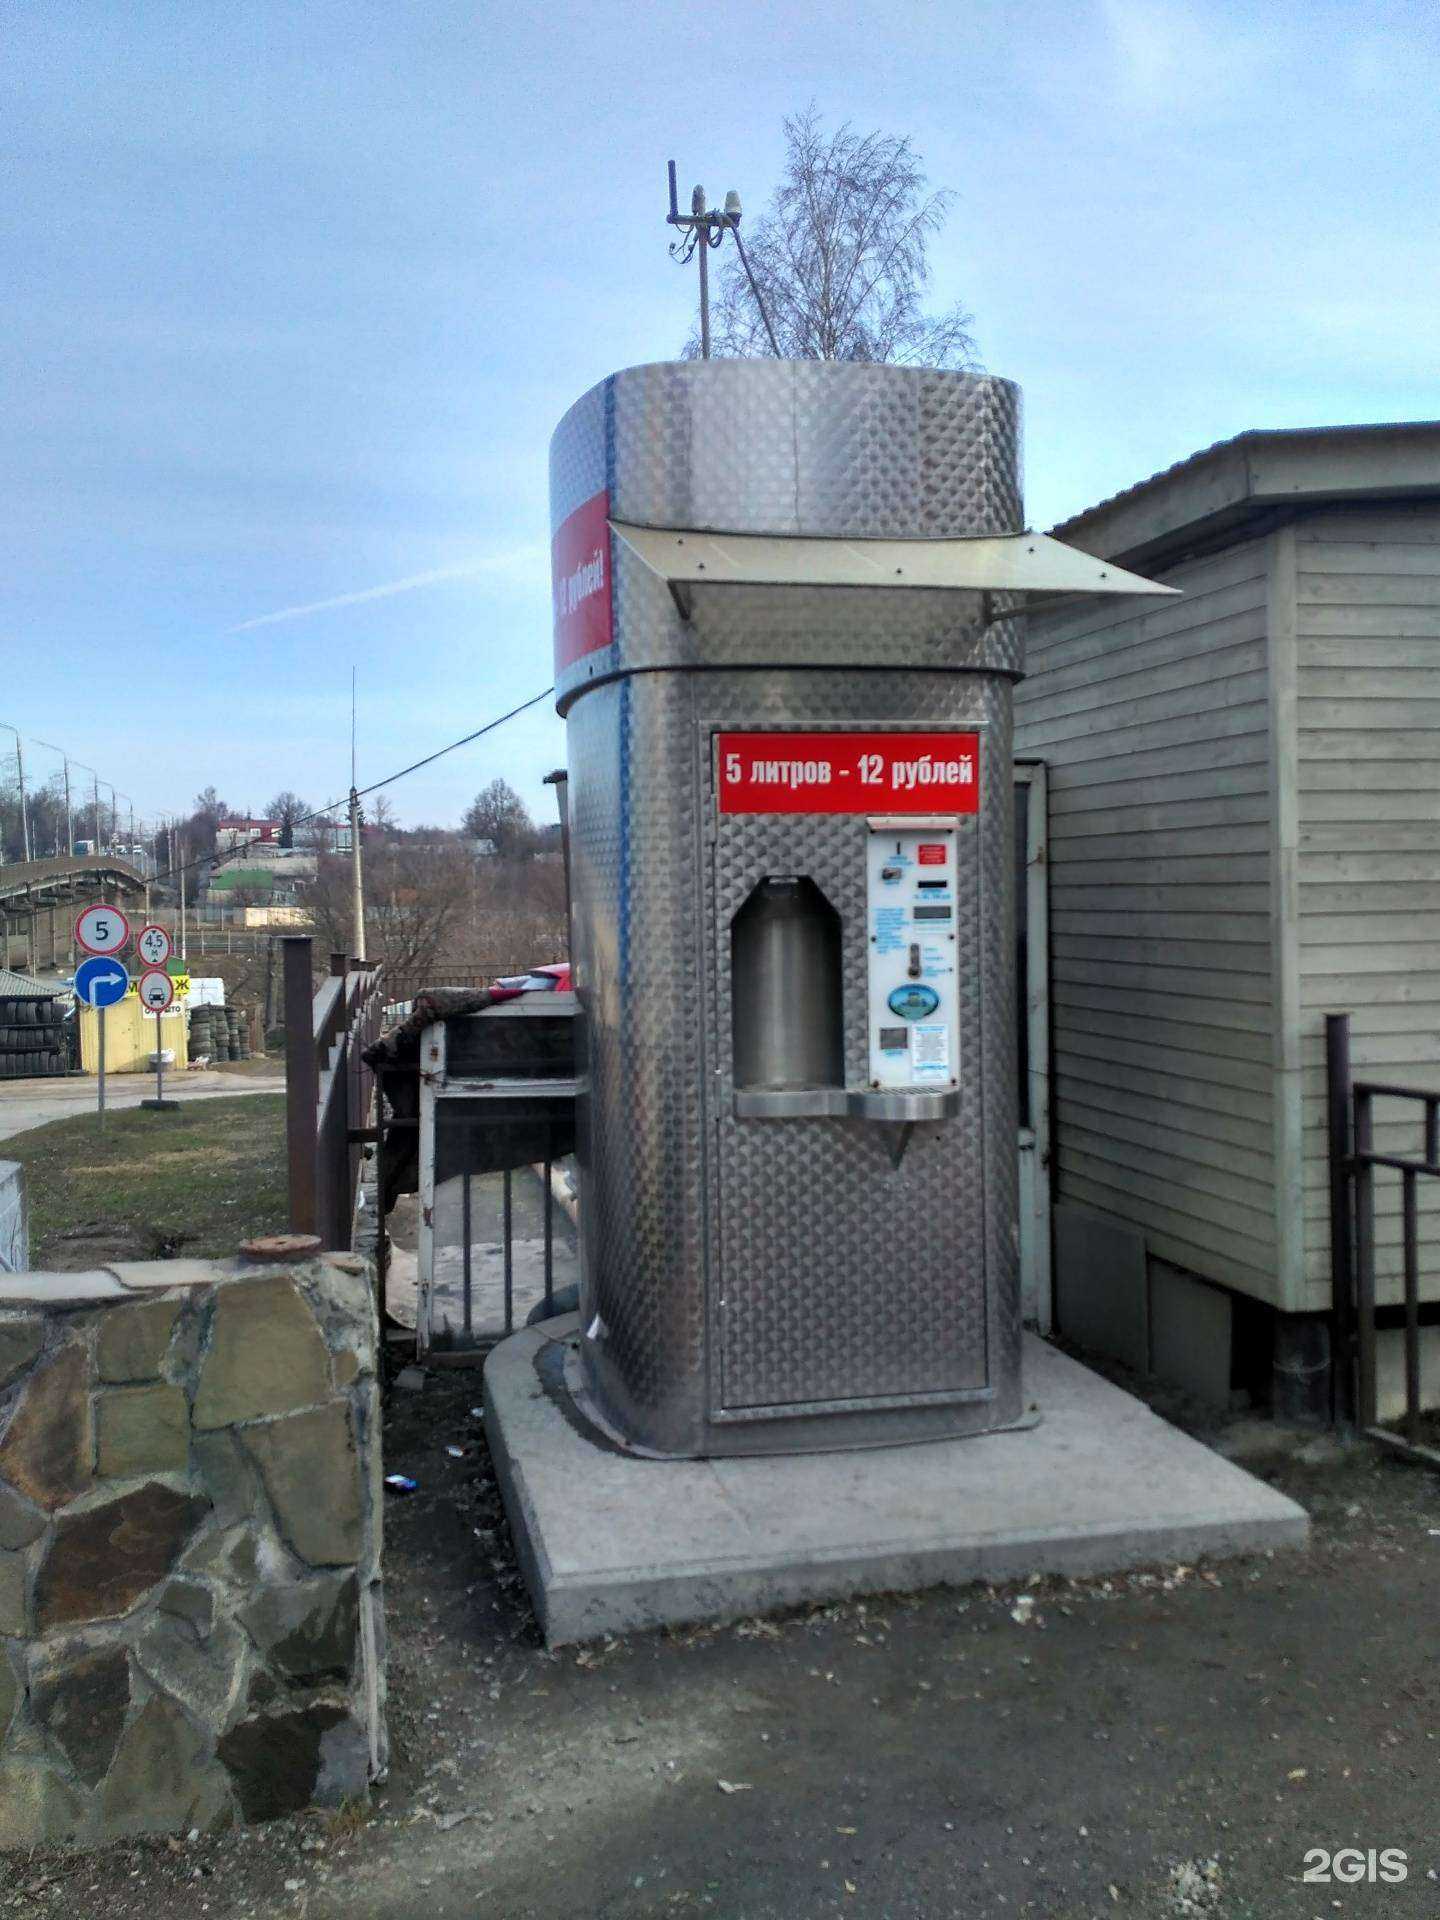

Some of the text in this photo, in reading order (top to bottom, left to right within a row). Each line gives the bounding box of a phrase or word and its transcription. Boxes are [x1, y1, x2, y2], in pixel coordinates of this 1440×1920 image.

[726, 753, 973, 790] 5 литров - 12 рублей
[95, 921, 109, 941] 5
